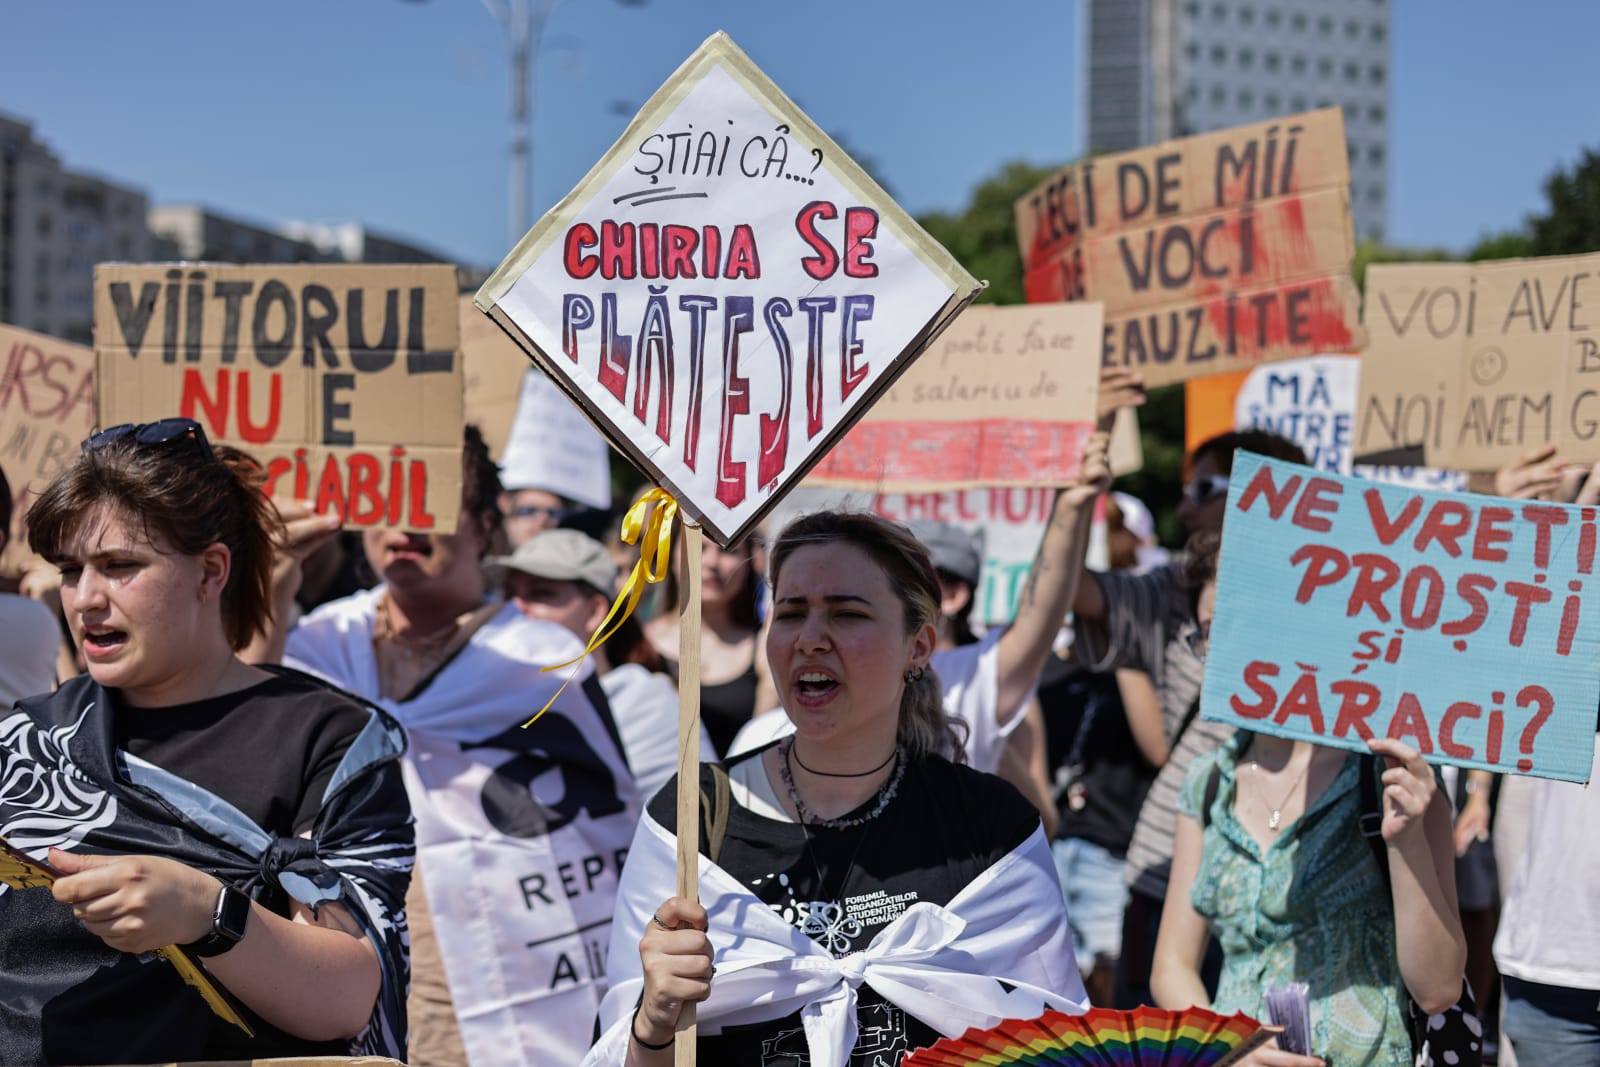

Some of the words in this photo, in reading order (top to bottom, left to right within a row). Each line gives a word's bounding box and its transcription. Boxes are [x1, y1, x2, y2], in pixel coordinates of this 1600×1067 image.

[1116, 154, 1182, 221] DE
[563, 219, 761, 280] CHIRIA
[795, 201, 879, 281] SE
[1118, 205, 1256, 292] VOCI
[109, 269, 455, 375] VIITORUL
[1102, 289, 1314, 369] EAUZITE
[1377, 275, 1477, 339] VOI
[1501, 272, 1600, 335] AVE
[179, 368, 282, 444] NU
[322, 373, 356, 447] E
[1359, 381, 1446, 449] NOI
[1457, 391, 1553, 449] AVEM
[261, 445, 435, 529] CIABIL
[1236, 465, 1344, 533] NE
[1289, 543, 1583, 657] PROȘTI
[1229, 660, 1555, 773] SĂRACI?
[845, 890, 888, 905] FORUMUL
[846, 892, 918, 913] ORGANIZAȚIILOR
